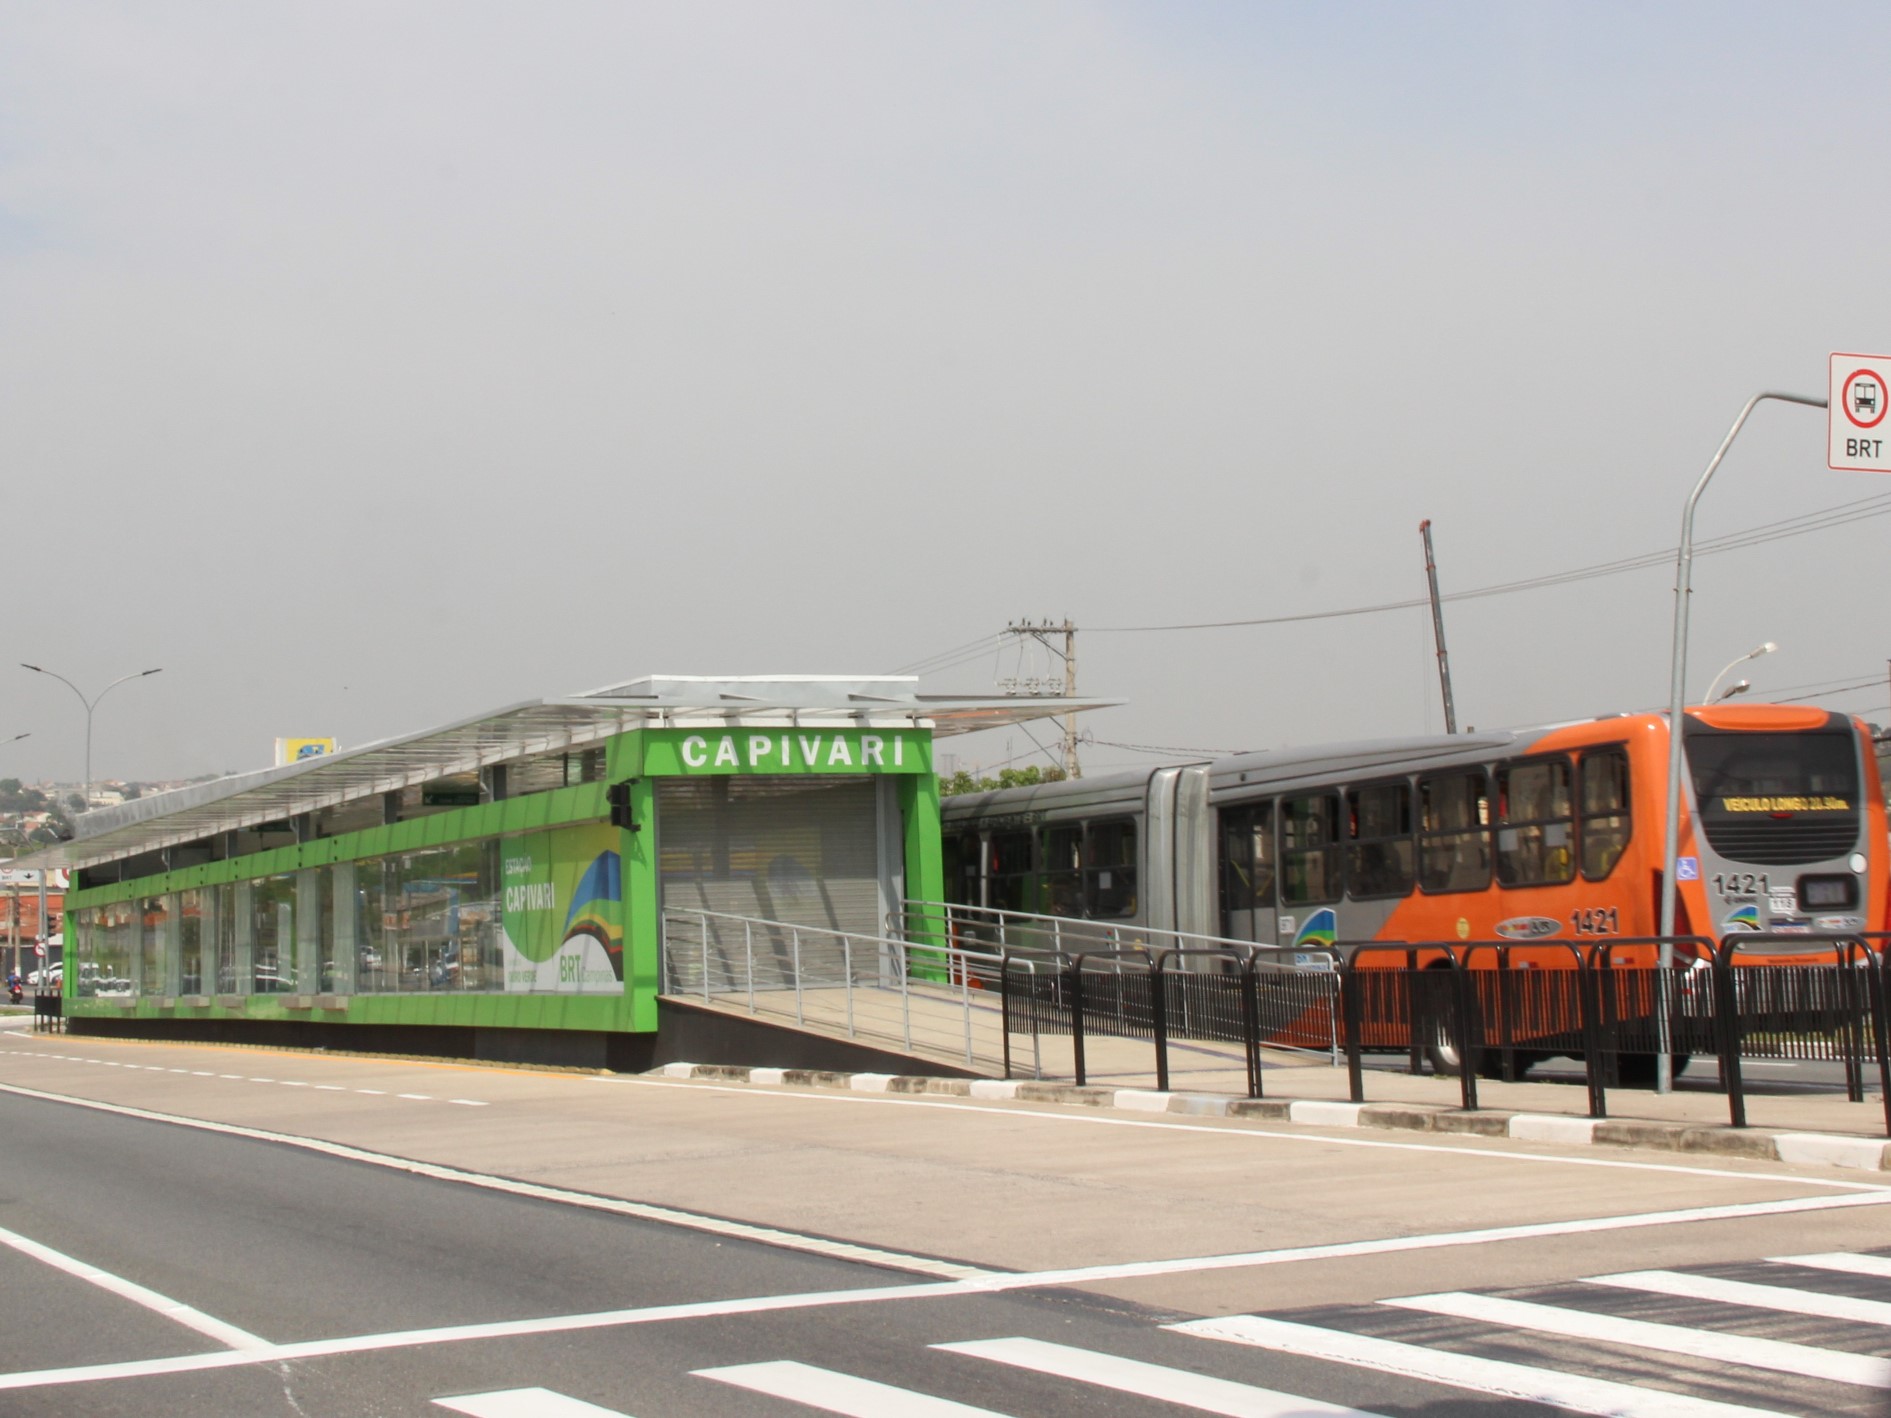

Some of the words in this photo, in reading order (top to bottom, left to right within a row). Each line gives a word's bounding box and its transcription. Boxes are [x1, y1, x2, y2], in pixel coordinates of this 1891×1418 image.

[1846, 438, 1883, 459] BRT
[682, 735, 902, 767] CAPIVARI
[506, 883, 555, 912] CAPIVARI
[1712, 872, 1770, 896] 1421
[1571, 907, 1619, 936] 1421
[560, 955, 581, 983] BRT
